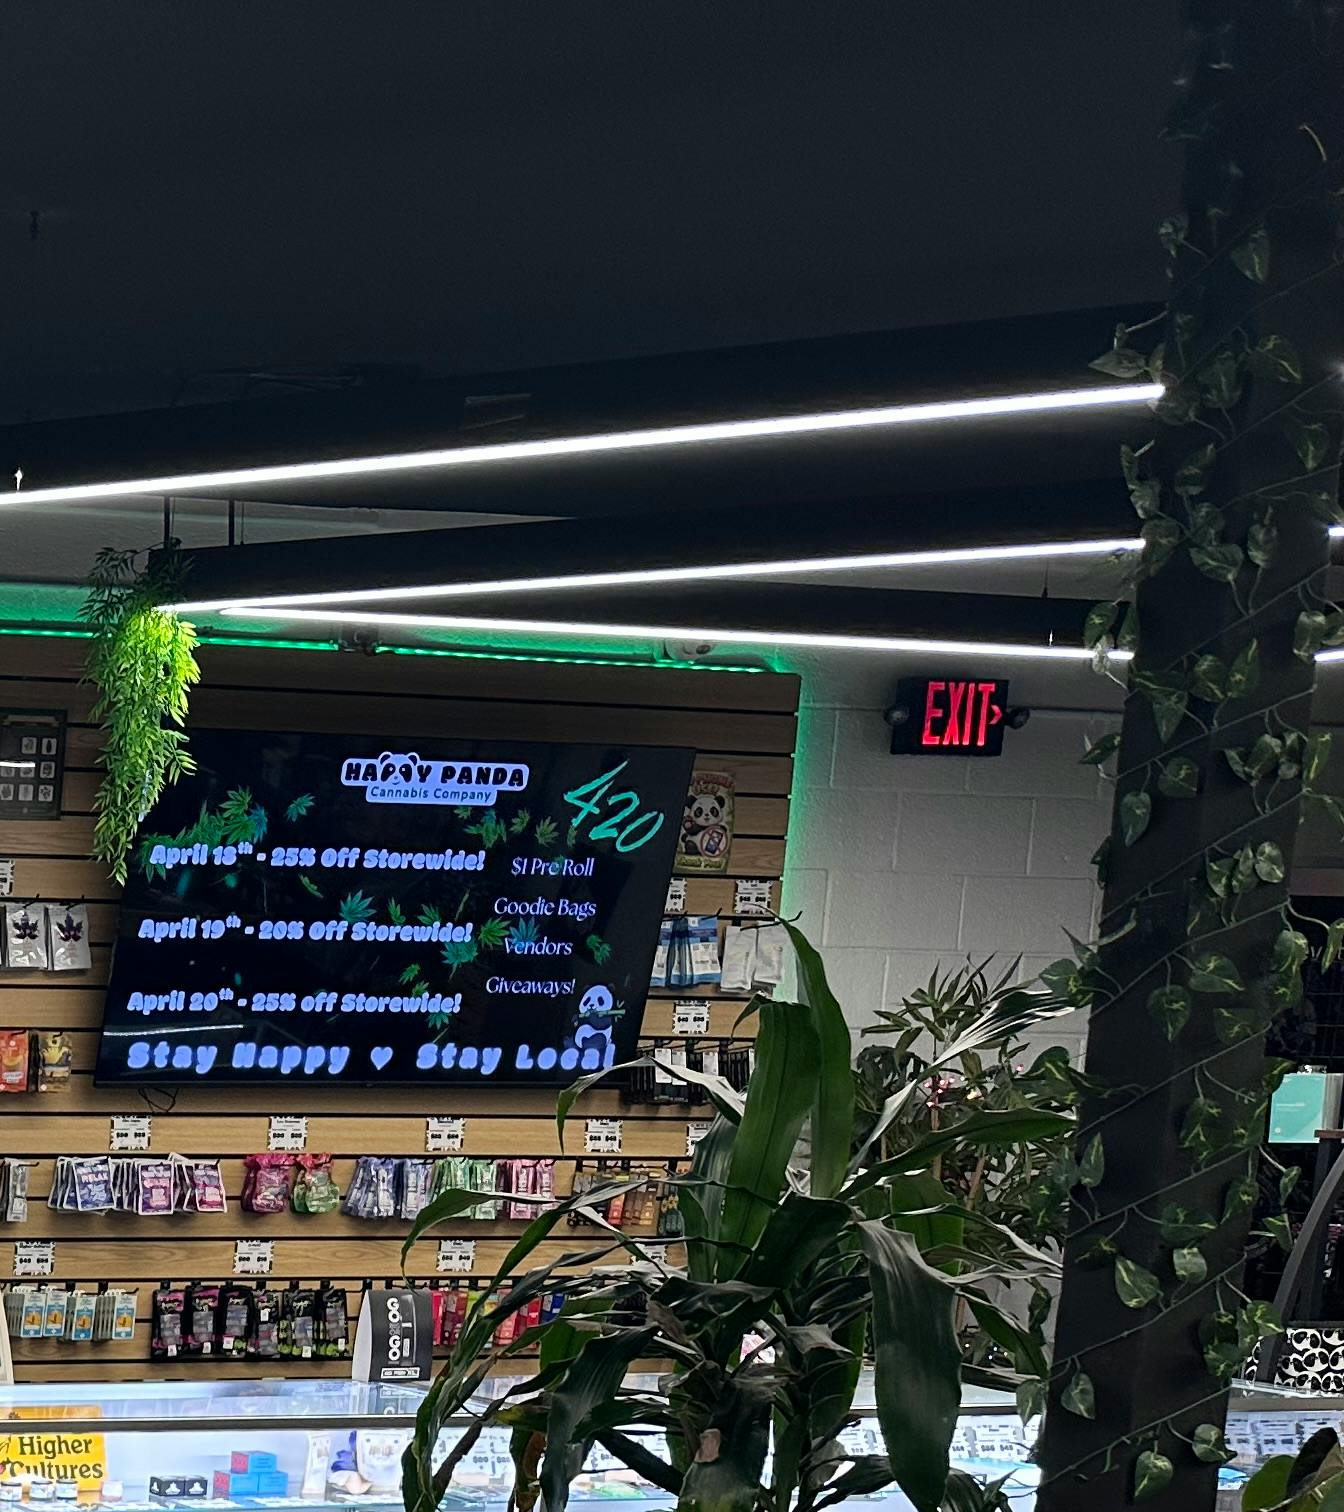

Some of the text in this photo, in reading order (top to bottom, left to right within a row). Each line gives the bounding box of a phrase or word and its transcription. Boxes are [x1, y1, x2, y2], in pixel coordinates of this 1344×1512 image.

[922, 680, 997, 747] EXIT
[440, 765, 524, 787] PANDA
[370, 786, 492, 802] Cannabis Company
[564, 759, 664, 851] 420
[150, 843, 208, 869] April
[271, 847, 316, 867] 25%
[321, 848, 360, 868] Off
[363, 849, 485, 872] Storewide!
[563, 858, 595, 877] Roll
[494, 897, 597, 921] Goodie Bags
[138, 917, 197, 943] April
[258, 920, 305, 940] 20%
[309, 920, 349, 940] Off
[351, 921, 473, 943] Storewide!
[504, 938, 573, 956] Vendors
[485, 976, 576, 998] Giveaways!
[127, 990, 185, 1016] April
[251, 992, 296, 1012] 25%
[301, 992, 339, 1013] off
[341, 993, 462, 1014] Storewide!
[127, 1041, 616, 1076] Stay Happy Stay Local
[18, 1434, 94, 1459] Higher
[10, 1458, 104, 1482] Cultures
